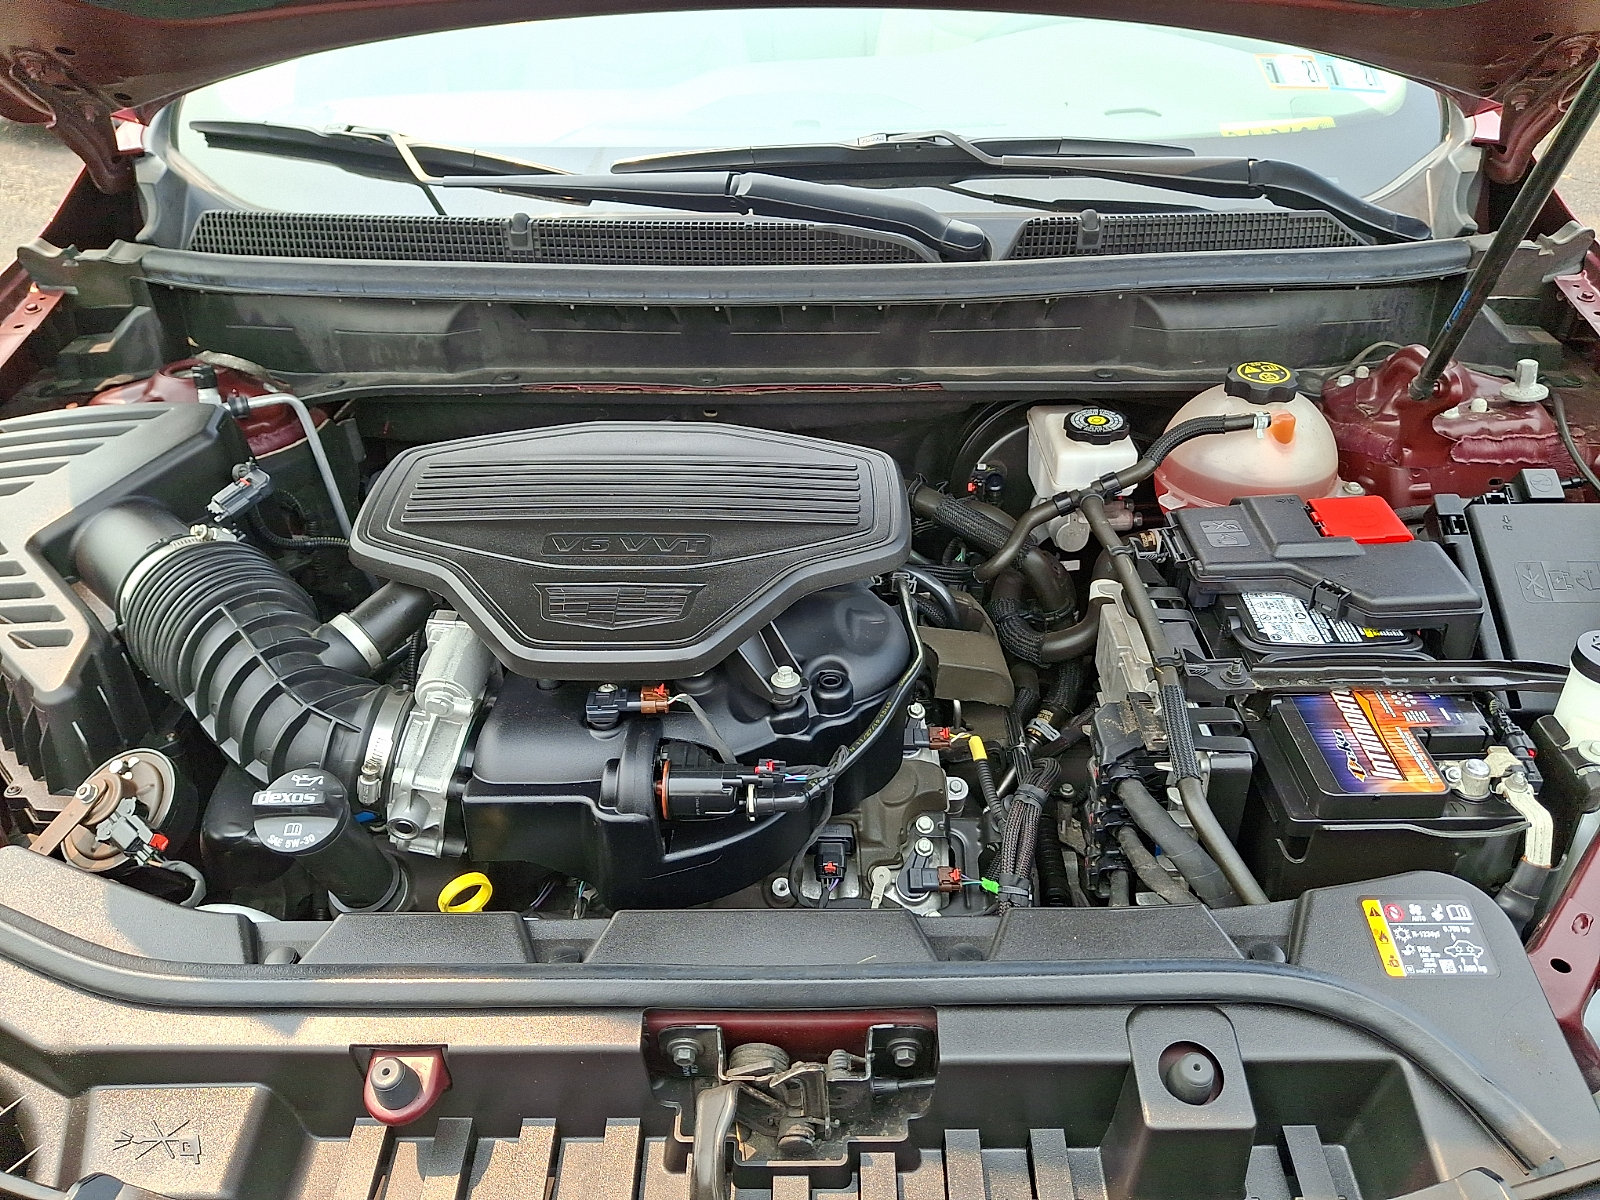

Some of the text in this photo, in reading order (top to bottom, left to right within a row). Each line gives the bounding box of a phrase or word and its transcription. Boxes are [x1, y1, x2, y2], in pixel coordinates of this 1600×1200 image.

[551, 537, 706, 552] V6 VVT
[258, 791, 319, 804] dexos
[267, 833, 316, 849] SAE 5W-30
